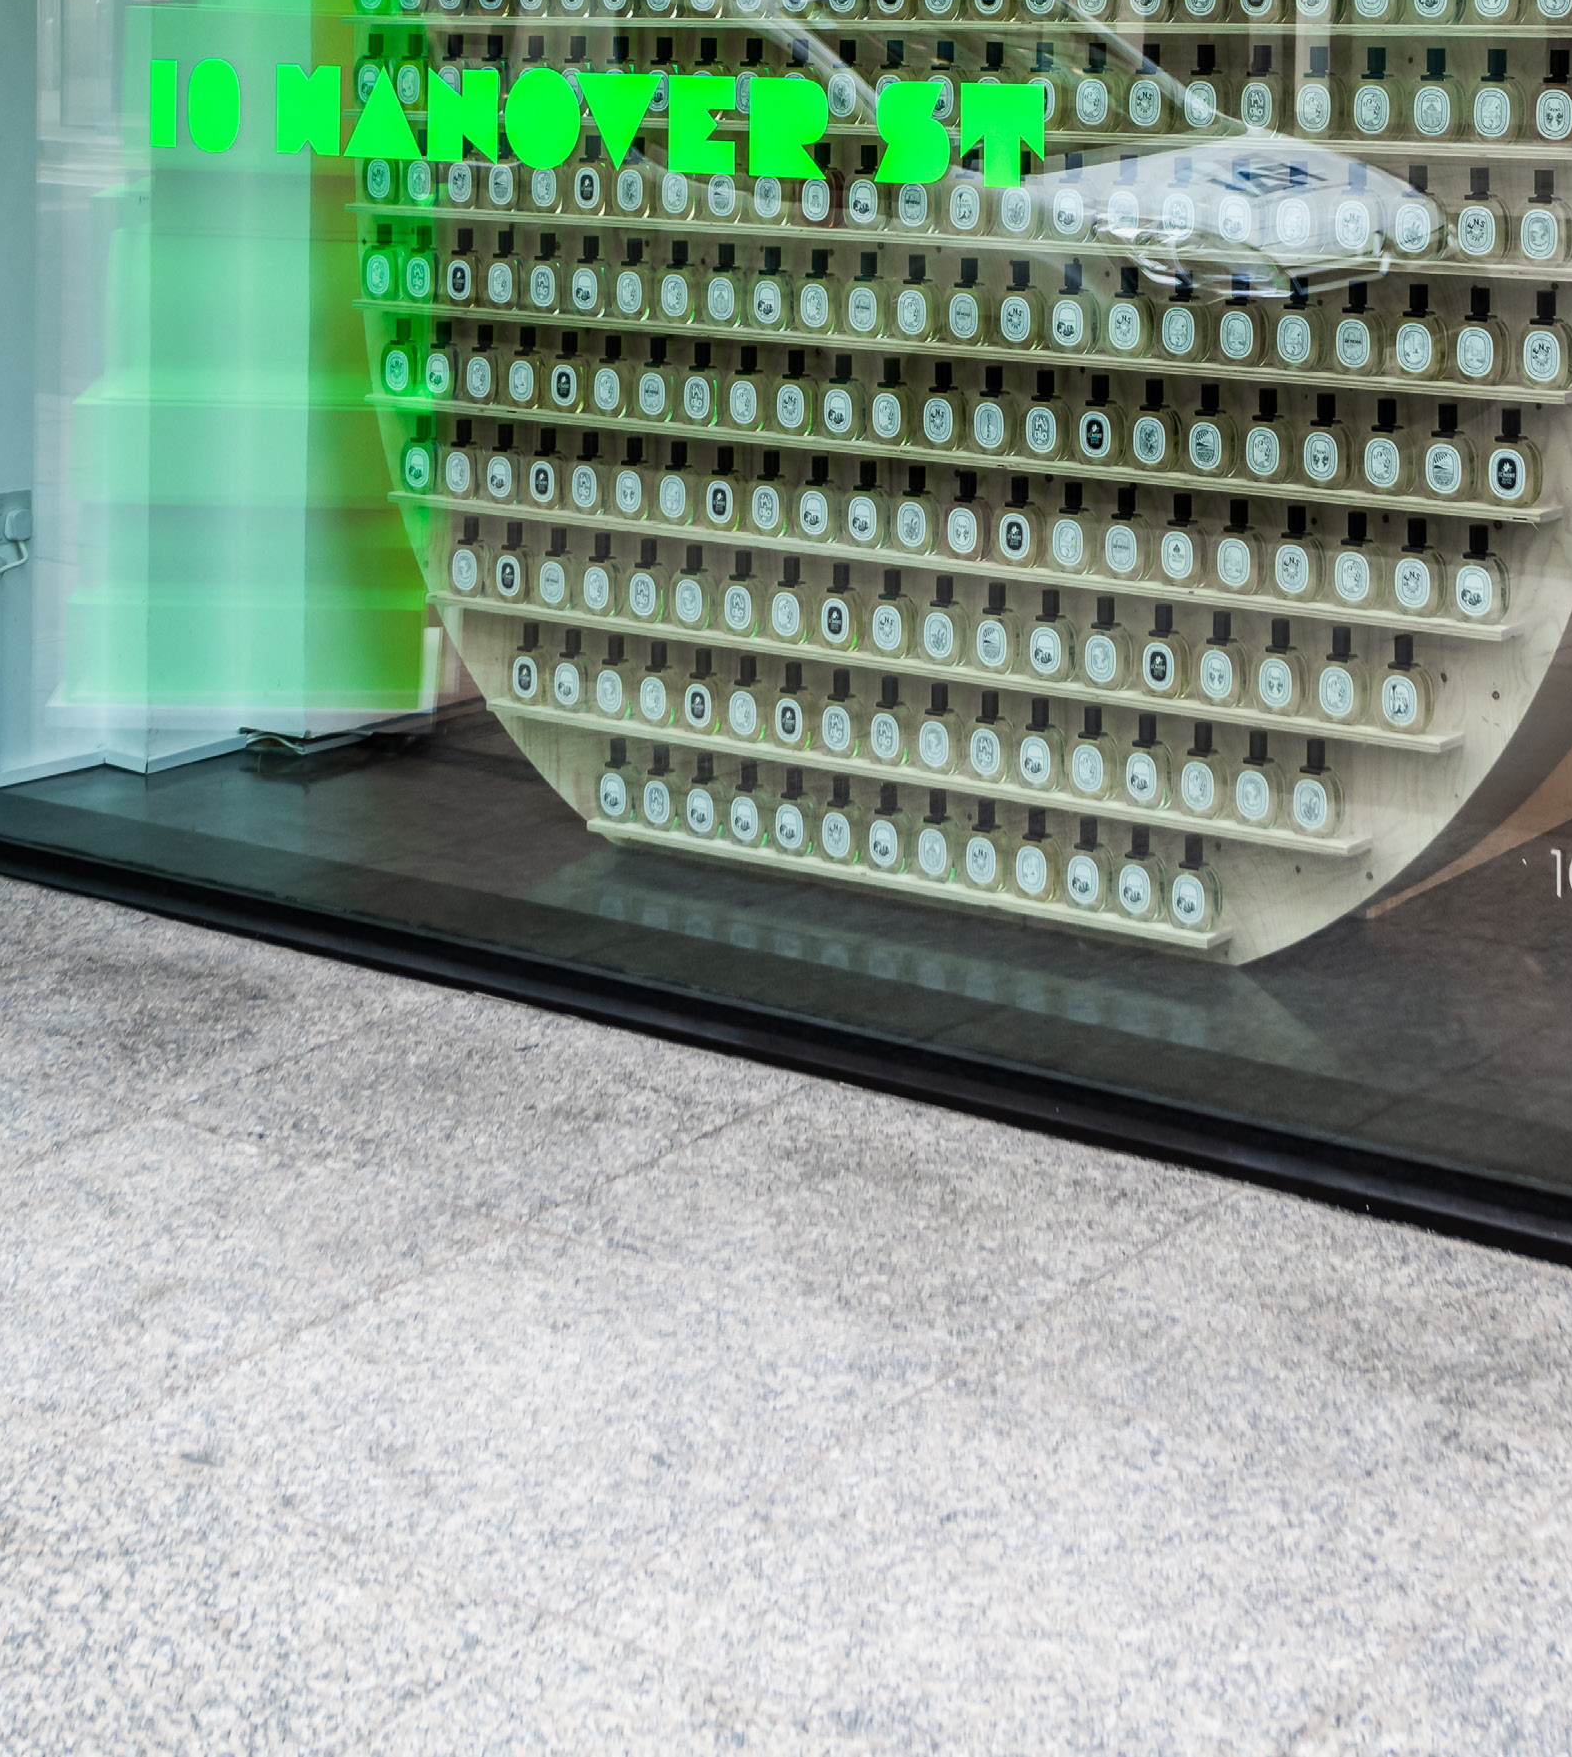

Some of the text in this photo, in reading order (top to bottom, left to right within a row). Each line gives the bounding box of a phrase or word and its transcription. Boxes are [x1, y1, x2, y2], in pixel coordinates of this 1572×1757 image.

[149, 59, 1045, 187] 10 HANOVER ST
